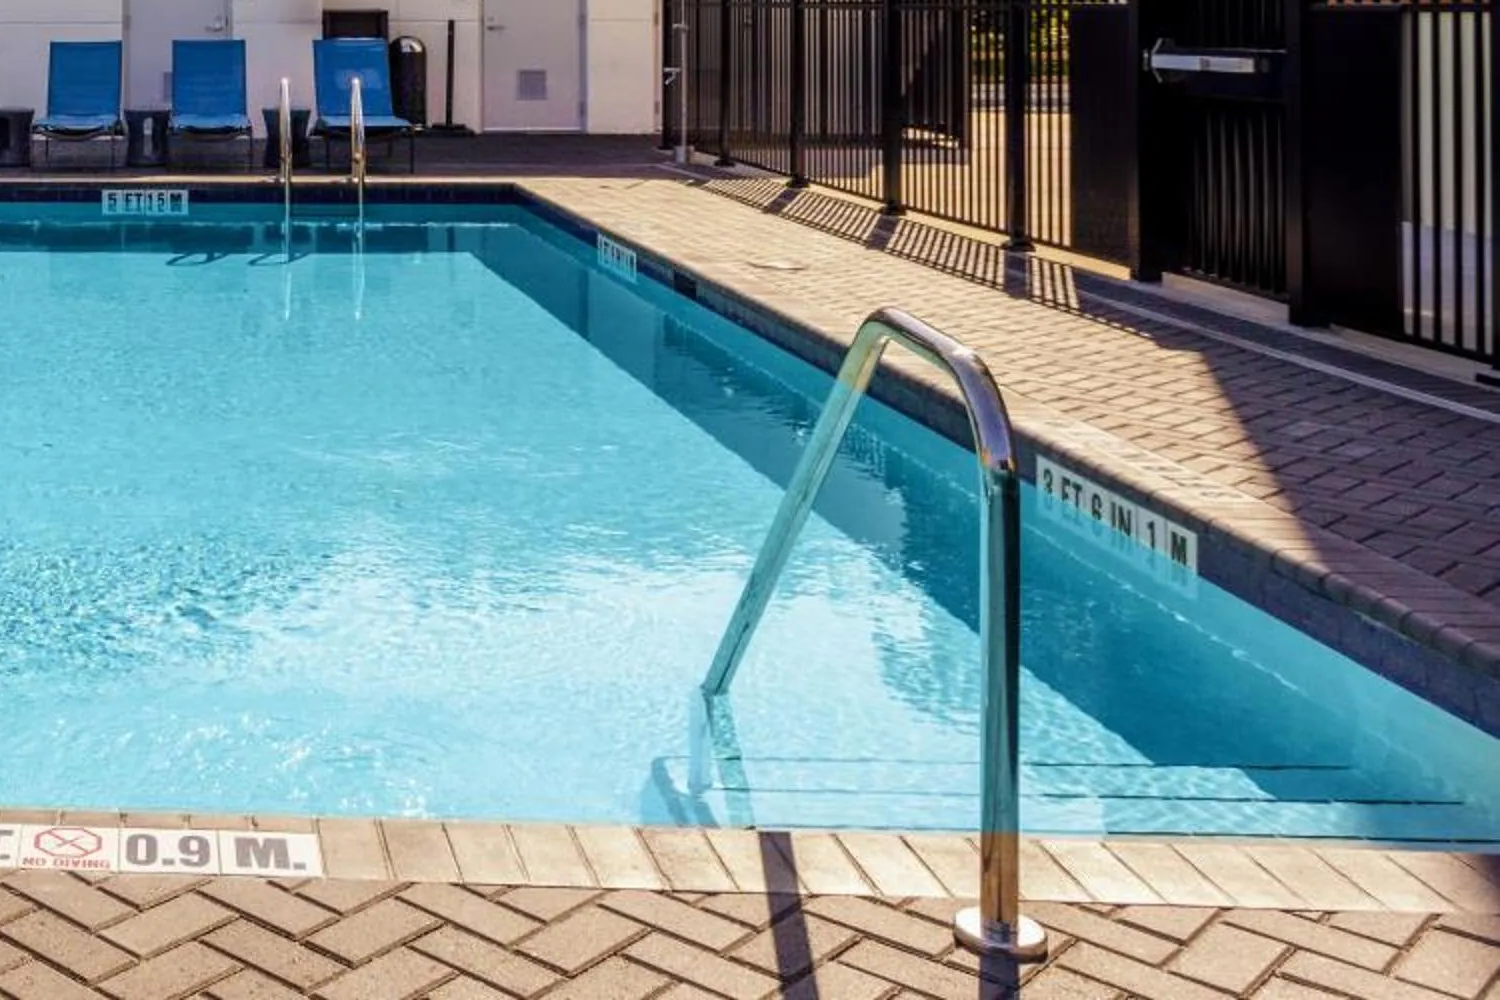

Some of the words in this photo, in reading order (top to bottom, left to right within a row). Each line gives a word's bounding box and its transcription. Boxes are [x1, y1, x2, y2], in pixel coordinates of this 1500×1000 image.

[107, 192, 117, 212] 5
[125, 193, 142, 212] FT
[169, 192, 183, 212] M
[1043, 468, 1054, 495] 3
[1061, 476, 1083, 509] FT
[1111, 501, 1132, 537] IN
[1147, 520, 1156, 550] 1
[1170, 531, 1188, 567] M
[23, 856, 47, 866] NO
[53, 858, 110, 869] DIVING
[126, 833, 211, 867] 0.9
[234, 837, 307, 870] M.
